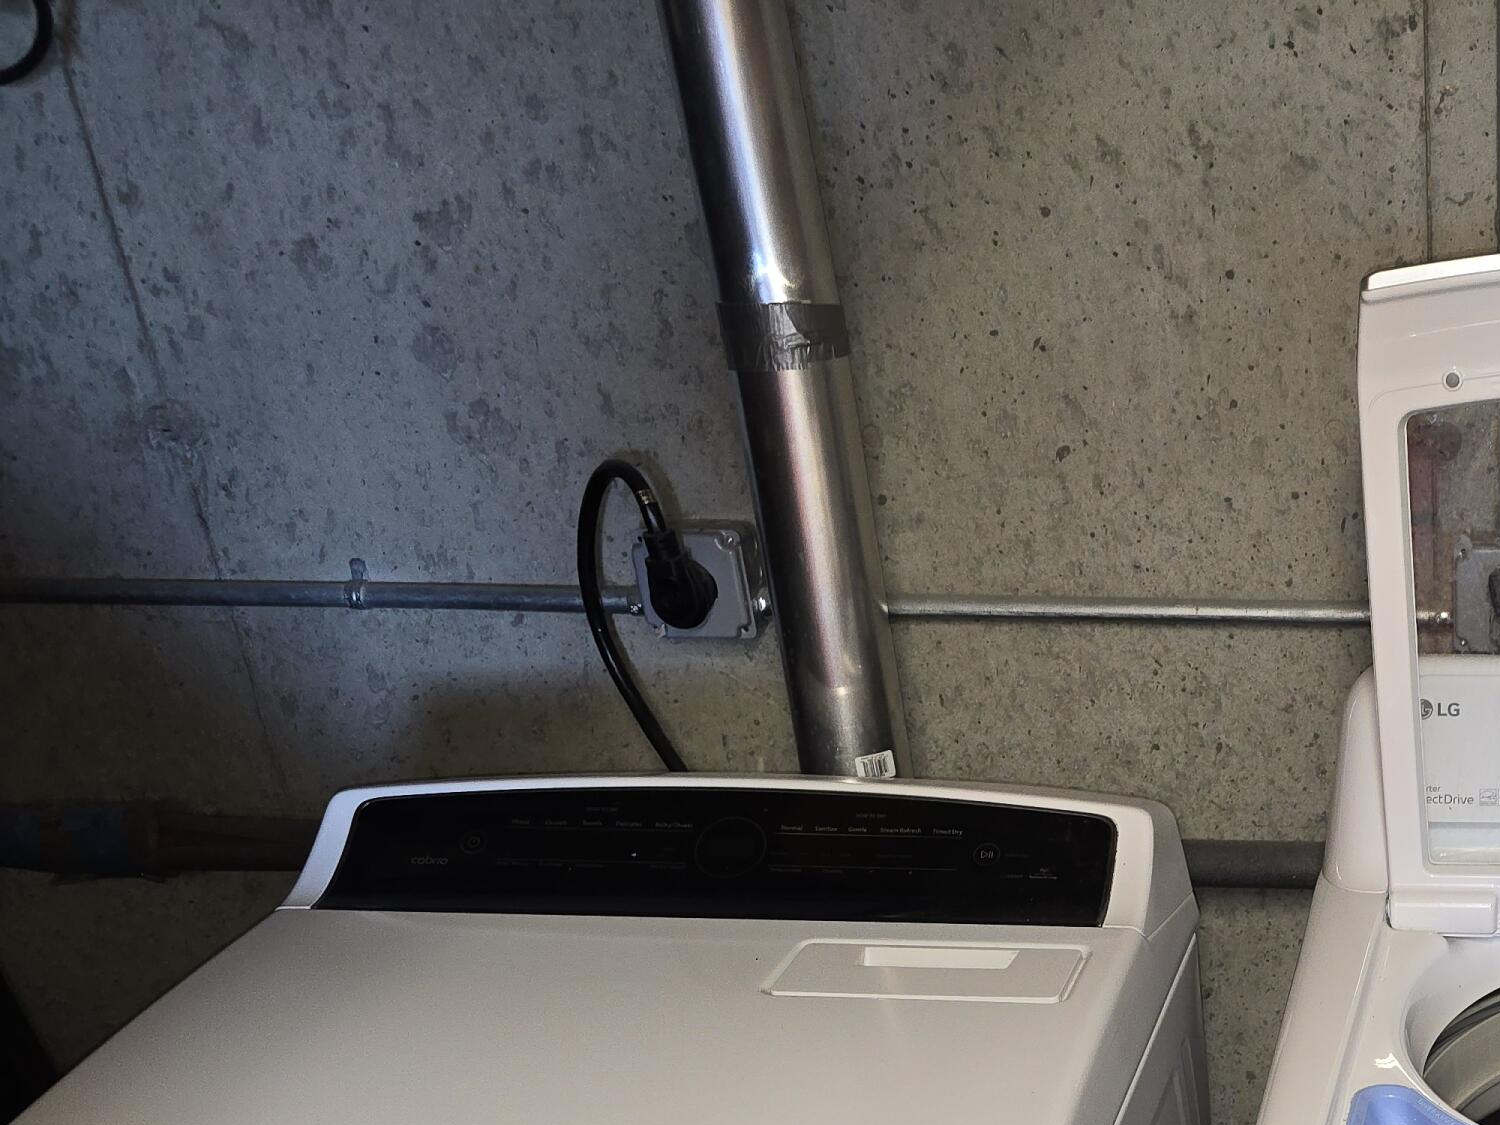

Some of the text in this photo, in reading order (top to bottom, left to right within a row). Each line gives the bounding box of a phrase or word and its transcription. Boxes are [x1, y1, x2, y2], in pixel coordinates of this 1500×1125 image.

[1437, 702, 1461, 717] LG
[1425, 785, 1441, 793] rter
[1425, 793, 1474, 805] ectDrive
